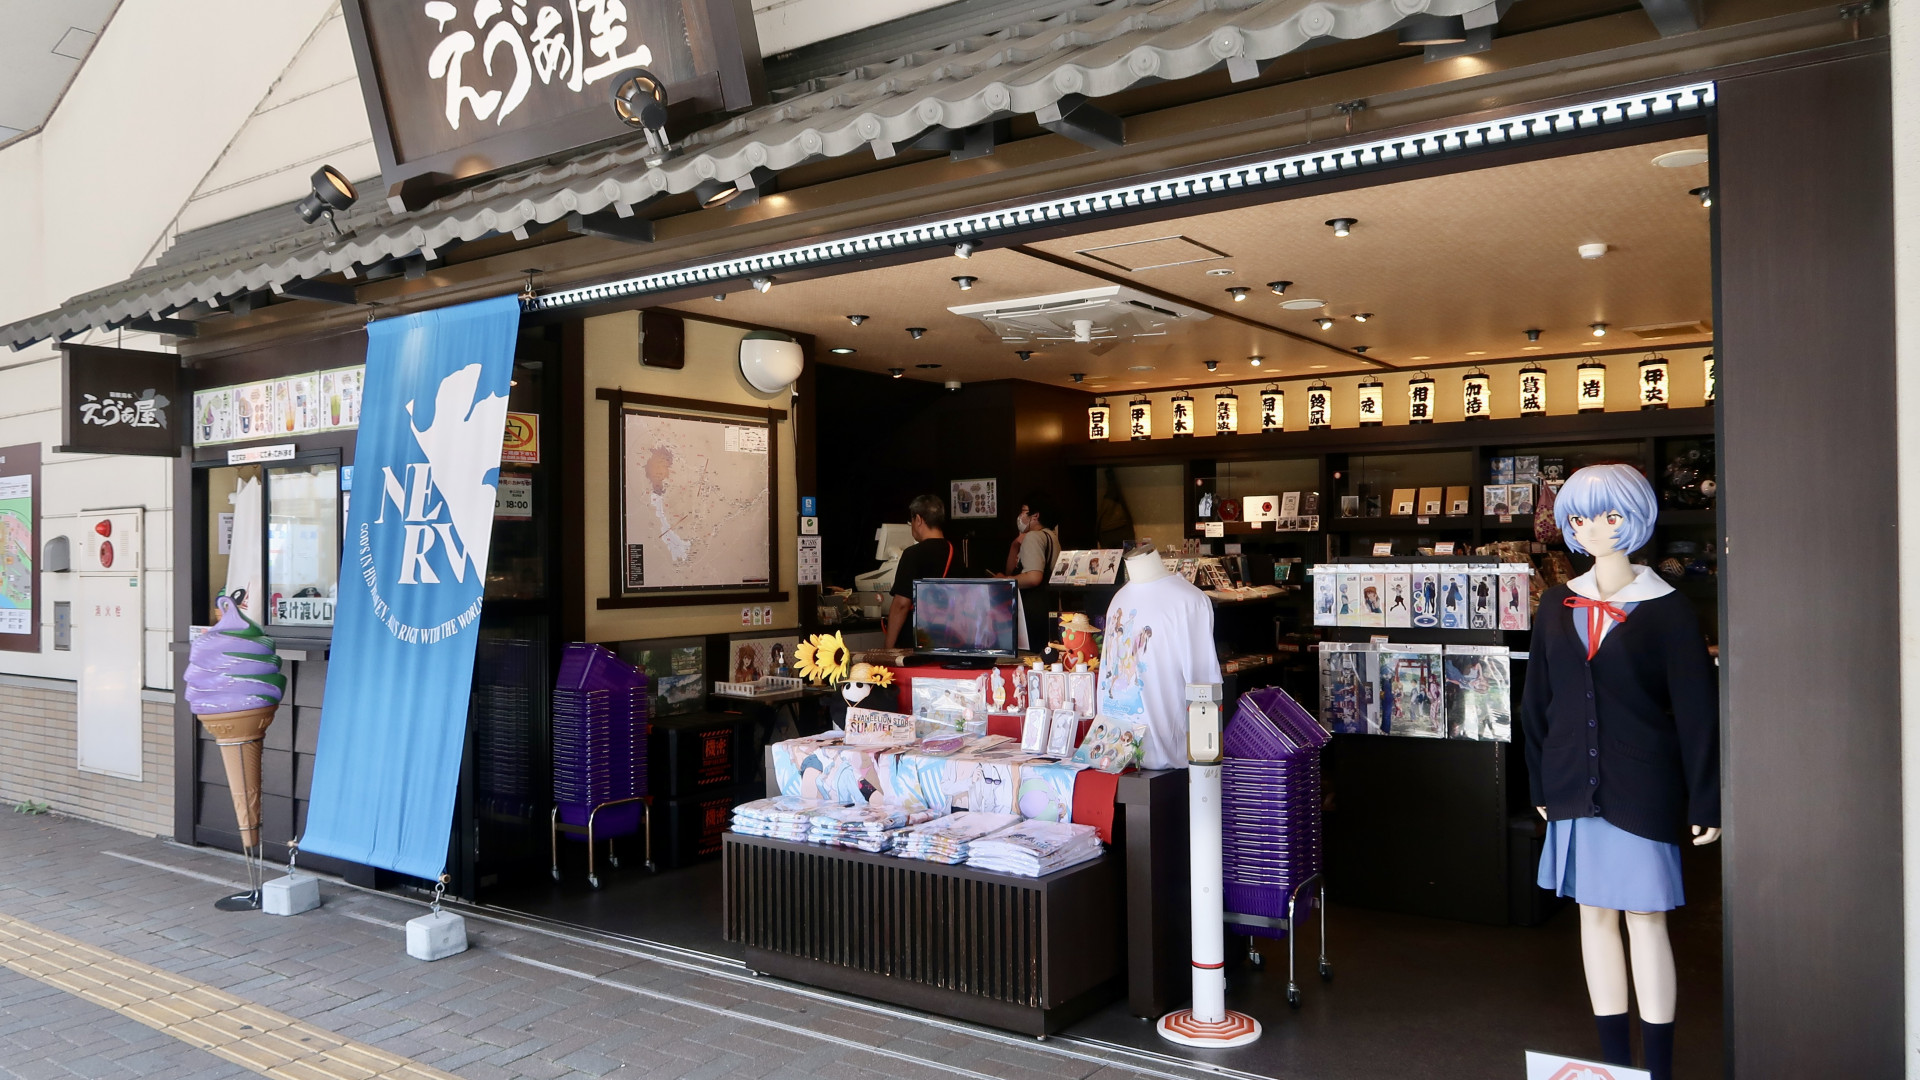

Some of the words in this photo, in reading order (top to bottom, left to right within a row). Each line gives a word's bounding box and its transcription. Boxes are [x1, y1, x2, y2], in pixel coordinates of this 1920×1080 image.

[1310, 393, 1326, 425] 鈴原
[1412, 386, 1429, 418] 相田
[1466, 382, 1482, 414] 加持
[1091, 411, 1105, 437] 日向
[1174, 403, 1187, 432] 赤木
[506, 500, 528, 509] 18:00
[359, 553, 374, 568] IN
[362, 565, 377, 587] HIS
[278, 601, 332, 621] 受け渡し口
[441, 618, 458, 640] THE
